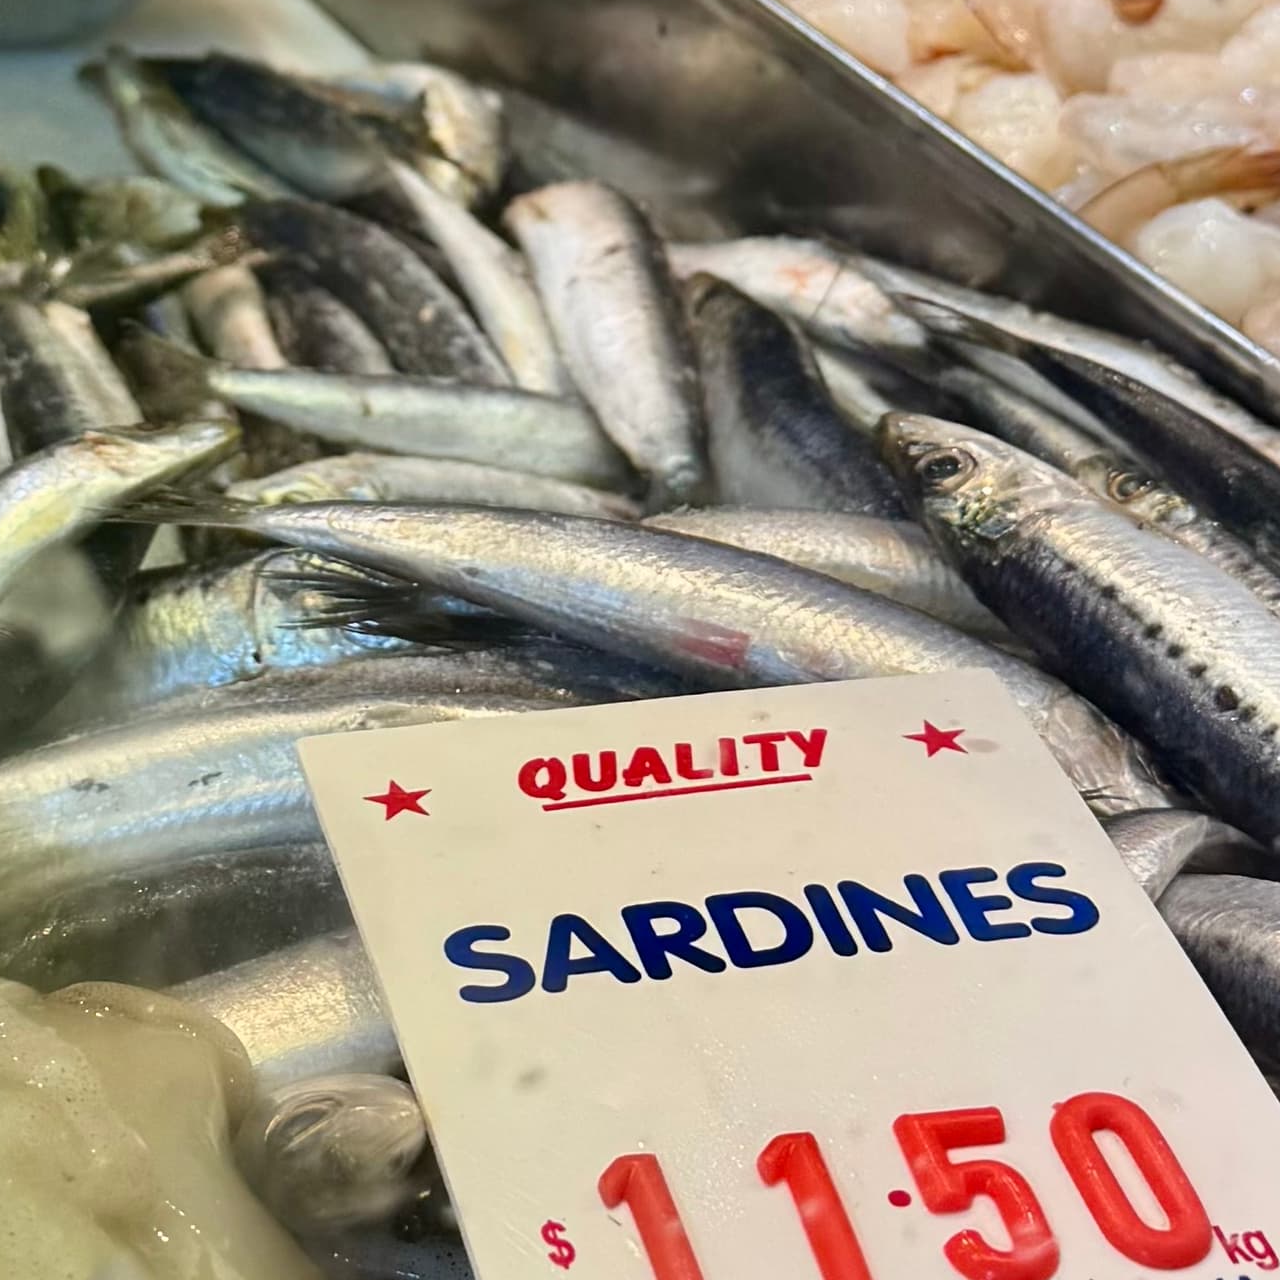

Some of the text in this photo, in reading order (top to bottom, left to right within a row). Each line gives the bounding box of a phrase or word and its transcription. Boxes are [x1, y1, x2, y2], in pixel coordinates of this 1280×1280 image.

[518, 728, 827, 800] QUALITY
[444, 862, 1100, 1003] SARDINES
[541, 1220, 575, 1270] $
[1213, 1226, 1280, 1269] kg
